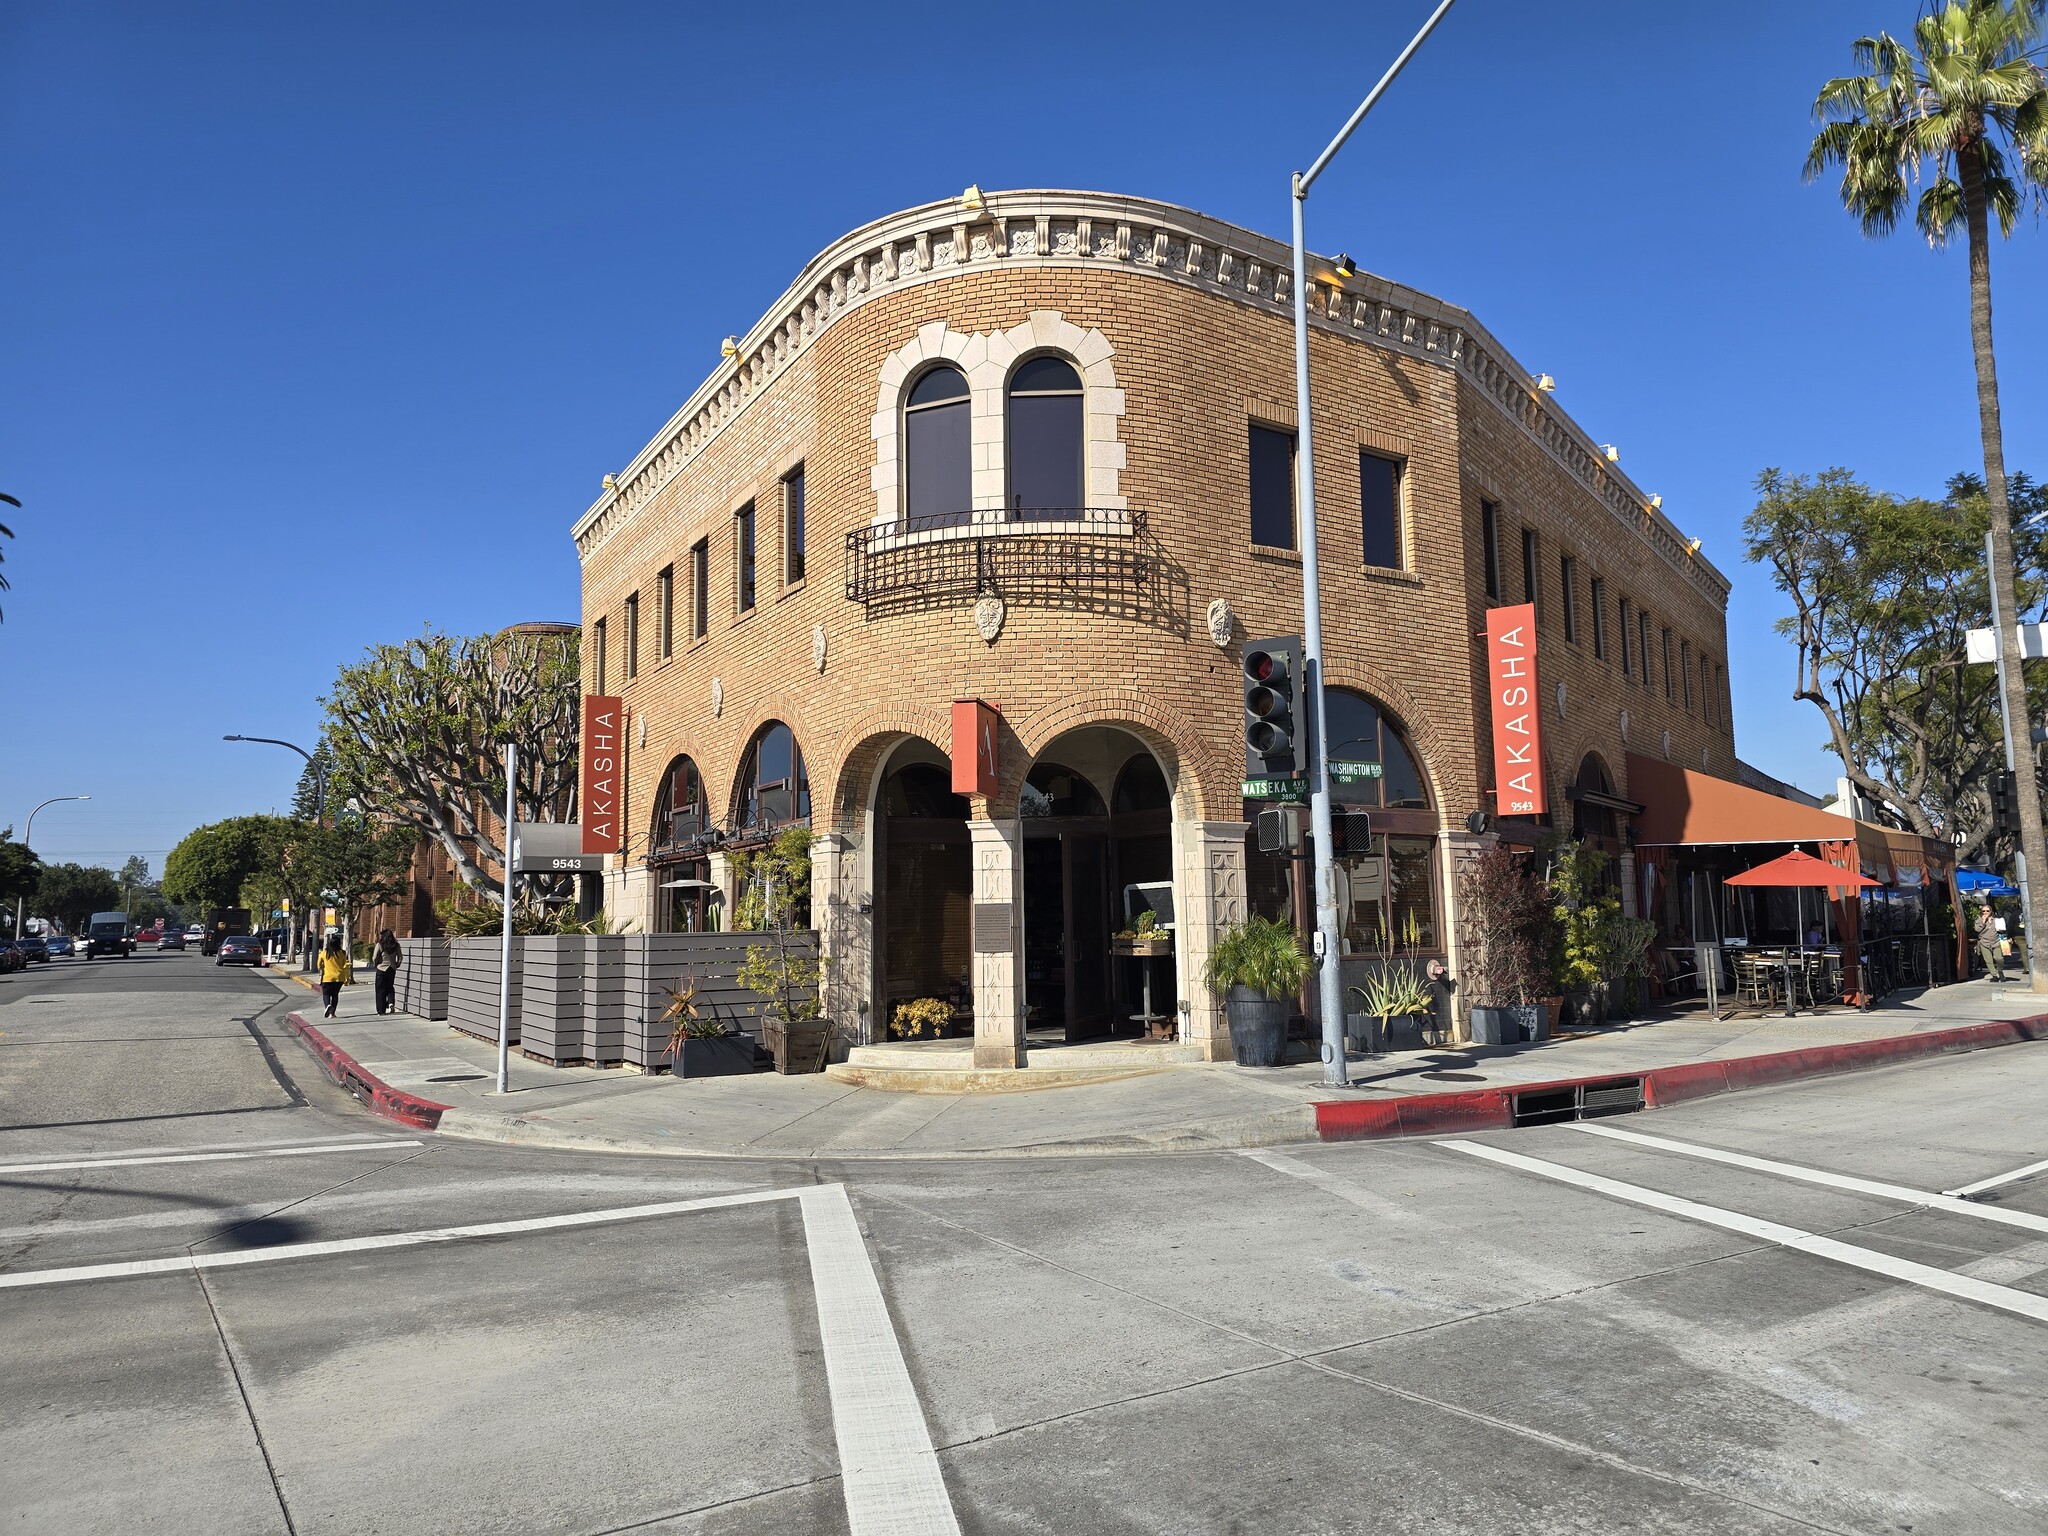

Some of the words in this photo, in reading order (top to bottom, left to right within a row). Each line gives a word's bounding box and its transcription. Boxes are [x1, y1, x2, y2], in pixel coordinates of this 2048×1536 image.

[1499, 625, 1534, 794] AKASHA
[592, 712, 614, 839] AKASHA
[1328, 762, 1371, 776] WASHINGTON
[1241, 781, 1288, 796] WATSEKA
[1511, 801, 1534, 812] 9543
[552, 859, 581, 869] 9543
